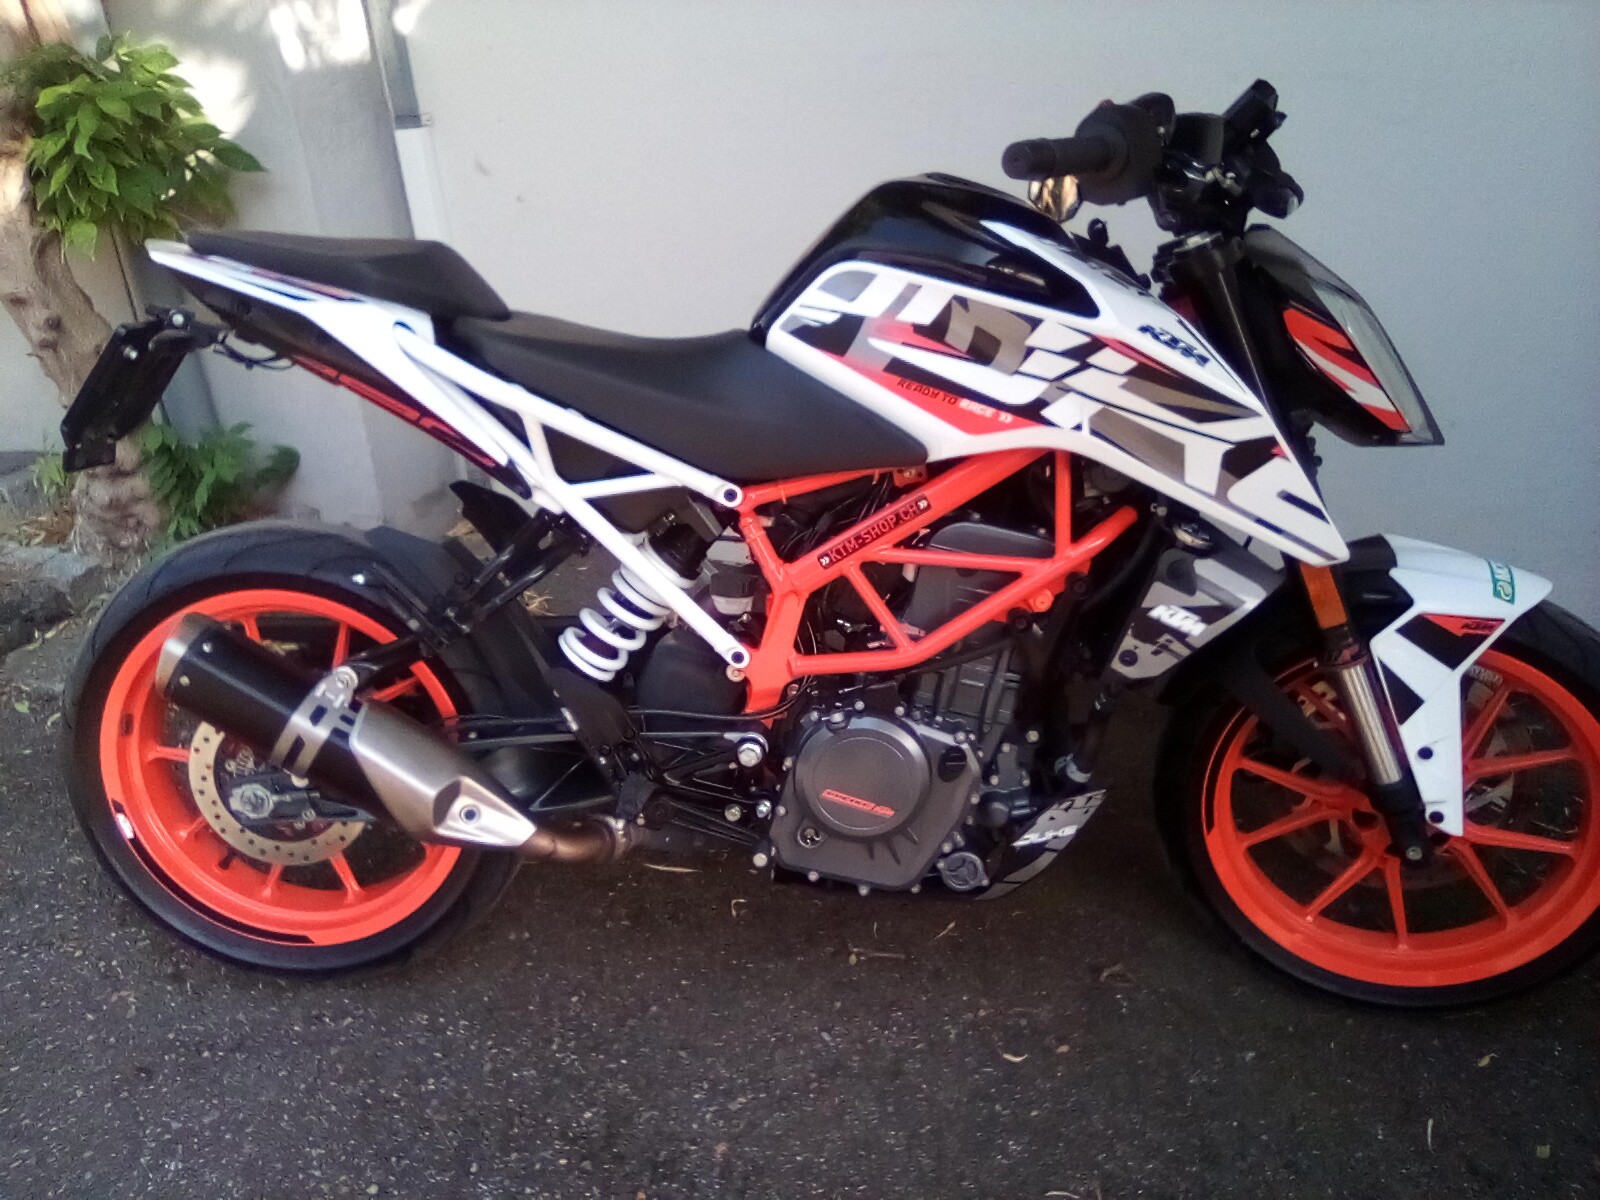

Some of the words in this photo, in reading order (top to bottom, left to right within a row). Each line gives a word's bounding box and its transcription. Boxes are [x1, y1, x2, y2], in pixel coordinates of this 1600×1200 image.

[1138, 325, 1210, 367] KTM
[897, 378, 939, 400] READY
[941, 393, 958, 406] TO
[828, 503, 918, 562] KTM-SHOP.CH
[1146, 603, 1207, 637] KTM
